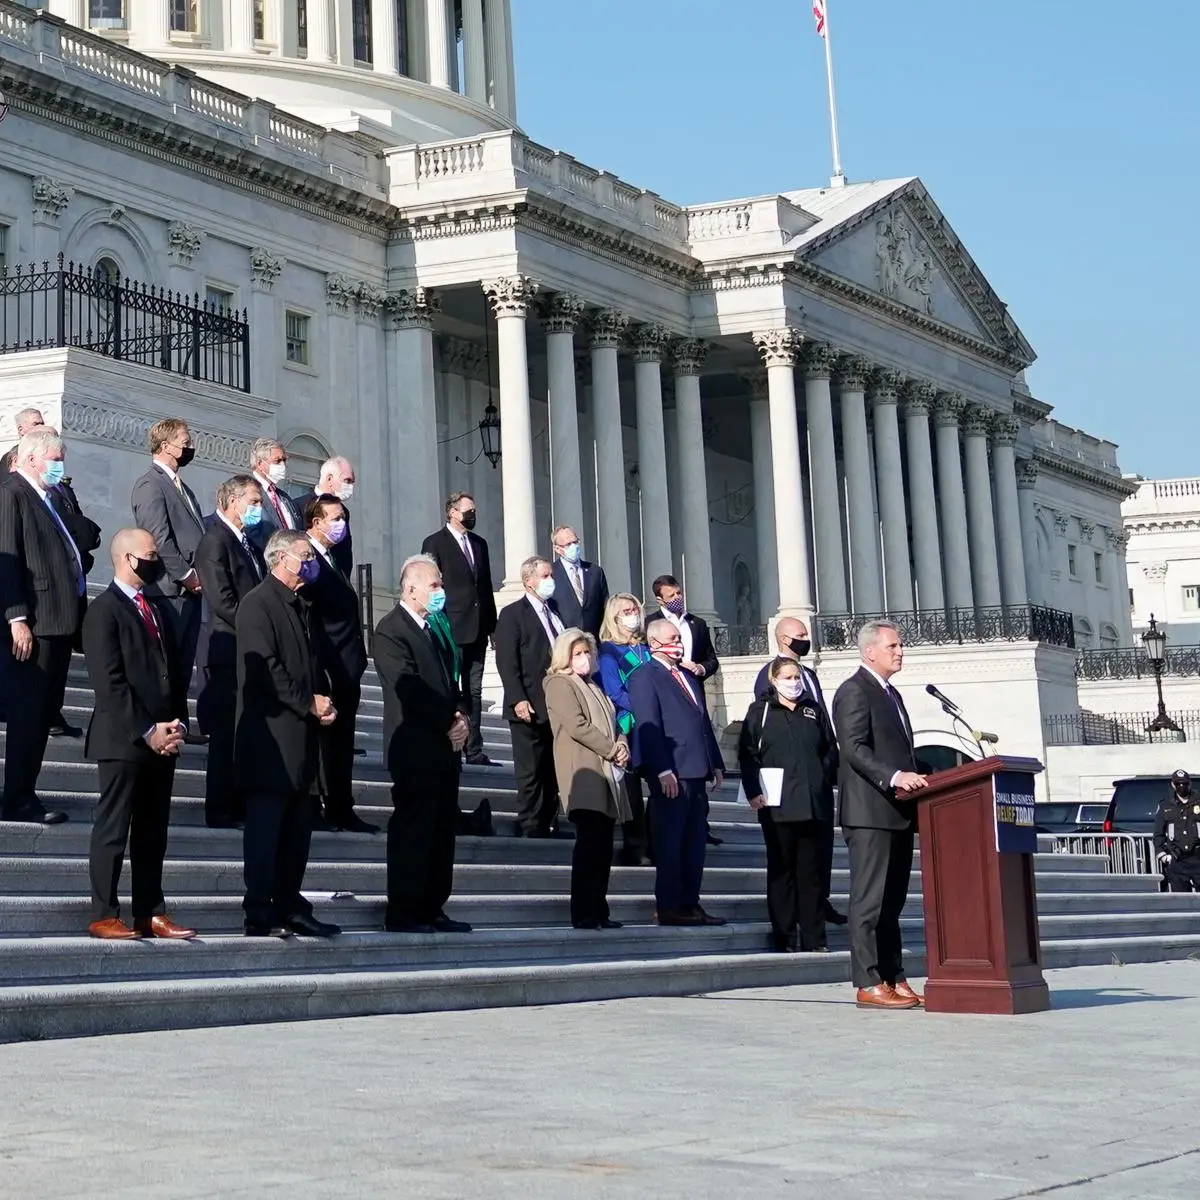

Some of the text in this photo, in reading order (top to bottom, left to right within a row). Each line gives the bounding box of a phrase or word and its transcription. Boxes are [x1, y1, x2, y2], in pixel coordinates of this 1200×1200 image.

[996, 792, 1034, 805] SMALL BUSINESS
[1015, 806, 1034, 823] TODAY
